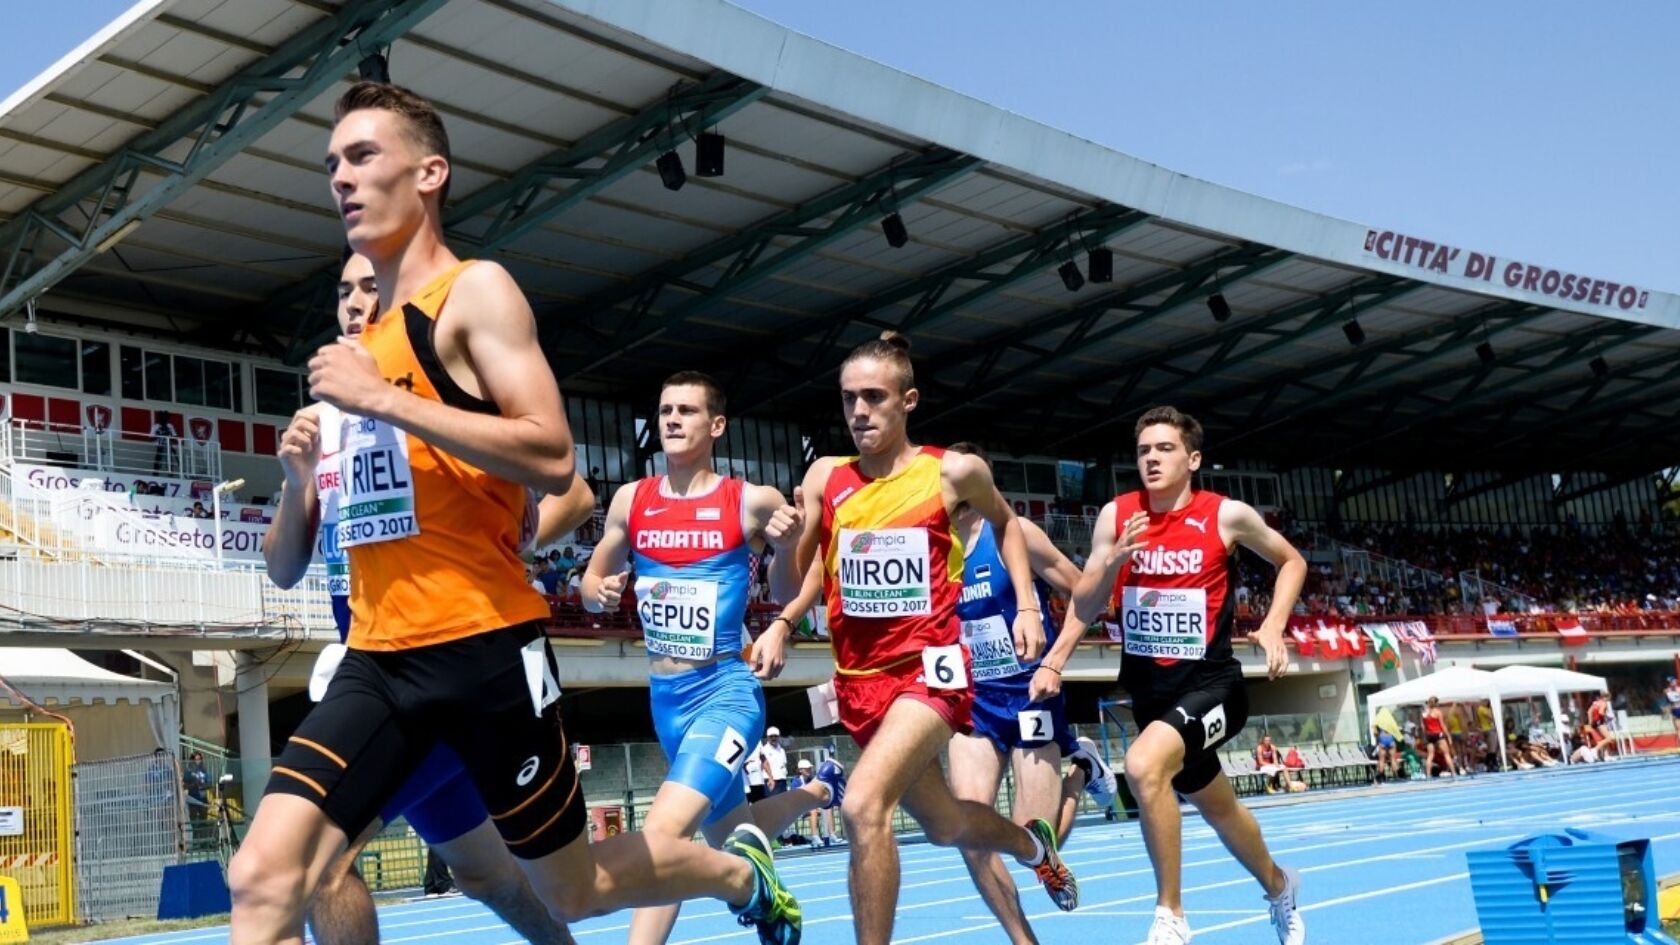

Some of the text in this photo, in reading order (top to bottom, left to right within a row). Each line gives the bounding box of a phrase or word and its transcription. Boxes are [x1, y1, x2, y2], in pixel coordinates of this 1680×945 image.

[1464, 252, 1496, 282] DI
[1503, 262, 1638, 310] GROSSETO
[28, 469, 126, 493] Grosto
[116, 521, 215, 550] Grosseto
[379, 516, 413, 536] 2017
[636, 529, 724, 549] CROATIA
[841, 557, 923, 586] MIRON
[641, 601, 710, 631] CEPUS
[902, 600, 928, 612] 2017
[1126, 609, 1202, 634] OESTER
[689, 646, 712, 659] 2017
[1127, 642, 1205, 656] GROSSETO 2017
[934, 655, 954, 684] 6
[1029, 717, 1046, 737] 2
[1208, 718, 1222, 739] 8
[726, 739, 745, 765] 7
